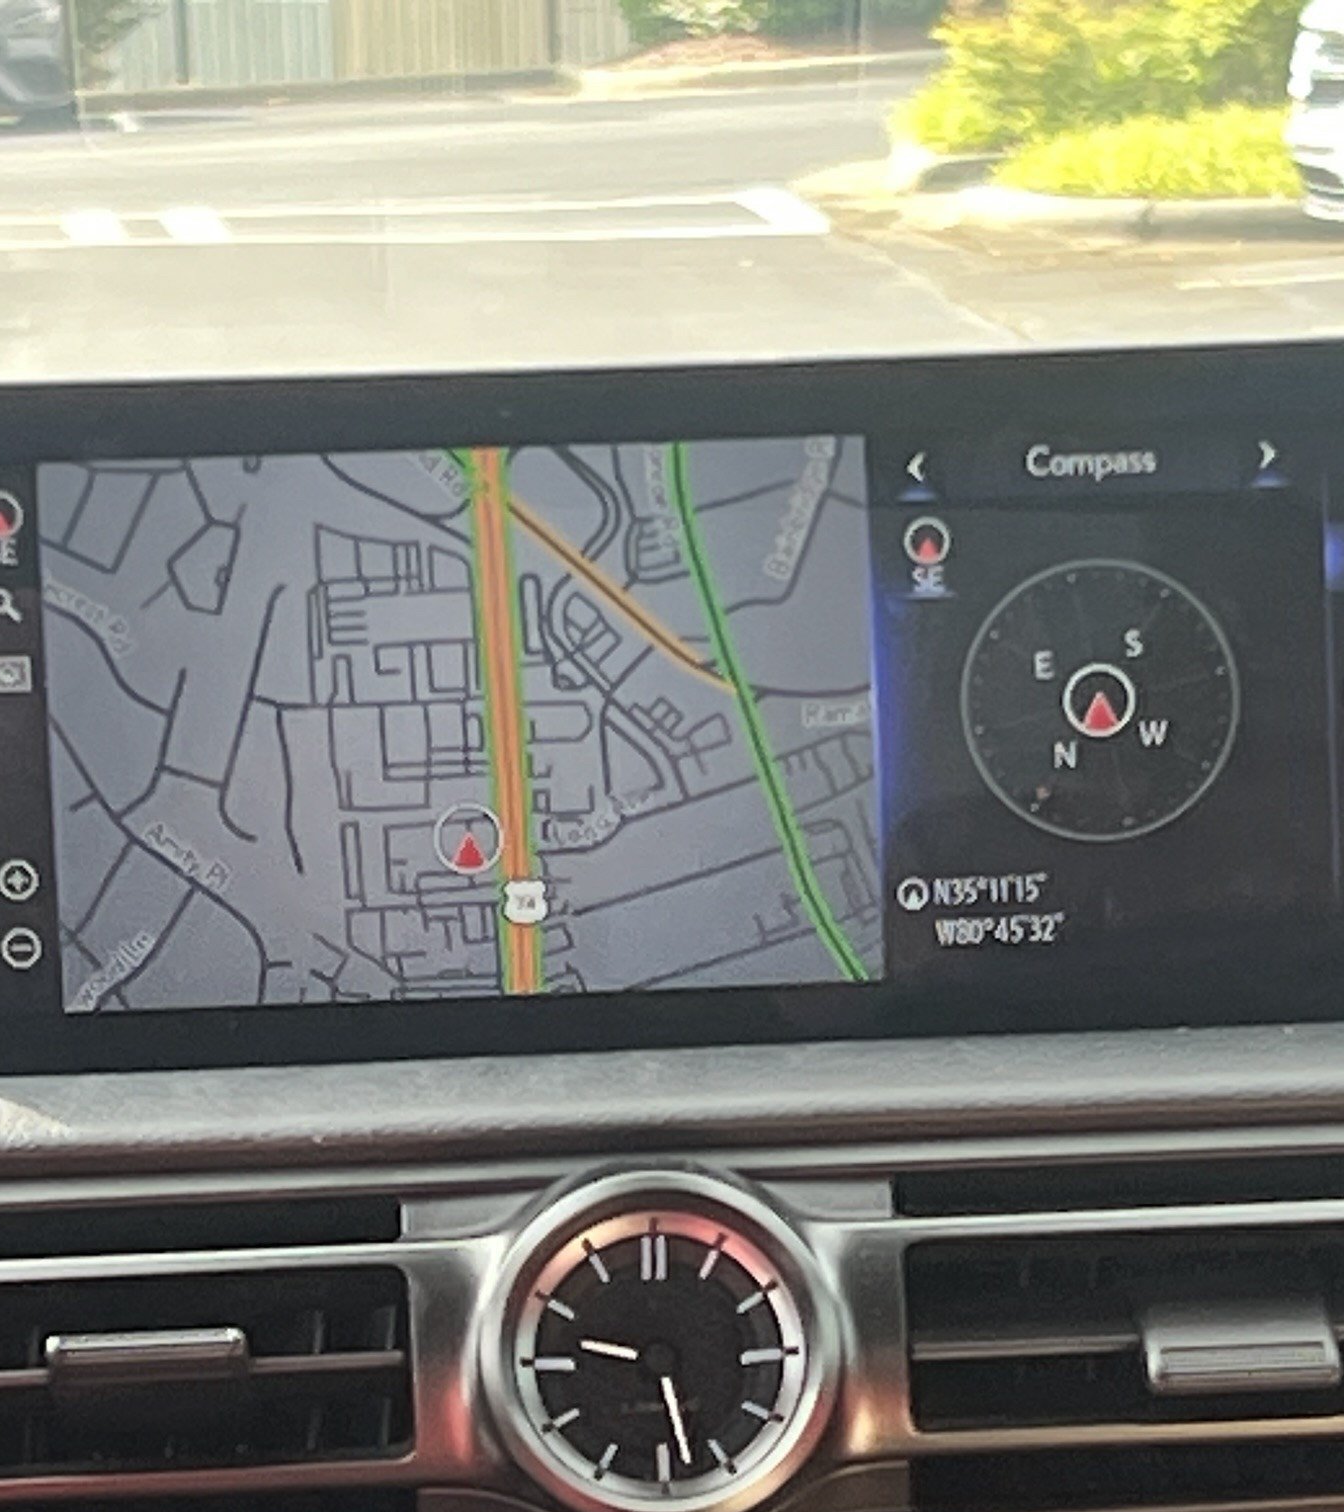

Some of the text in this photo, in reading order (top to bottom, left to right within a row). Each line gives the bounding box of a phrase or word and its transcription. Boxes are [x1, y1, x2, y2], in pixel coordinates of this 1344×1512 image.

[1025, 444, 1156, 482] Compass
[911, 565, 945, 593] SE
[1124, 628, 1144, 657] S
[1034, 650, 1054, 680] E
[1138, 718, 1169, 747] W
[1054, 740, 1077, 769] N
